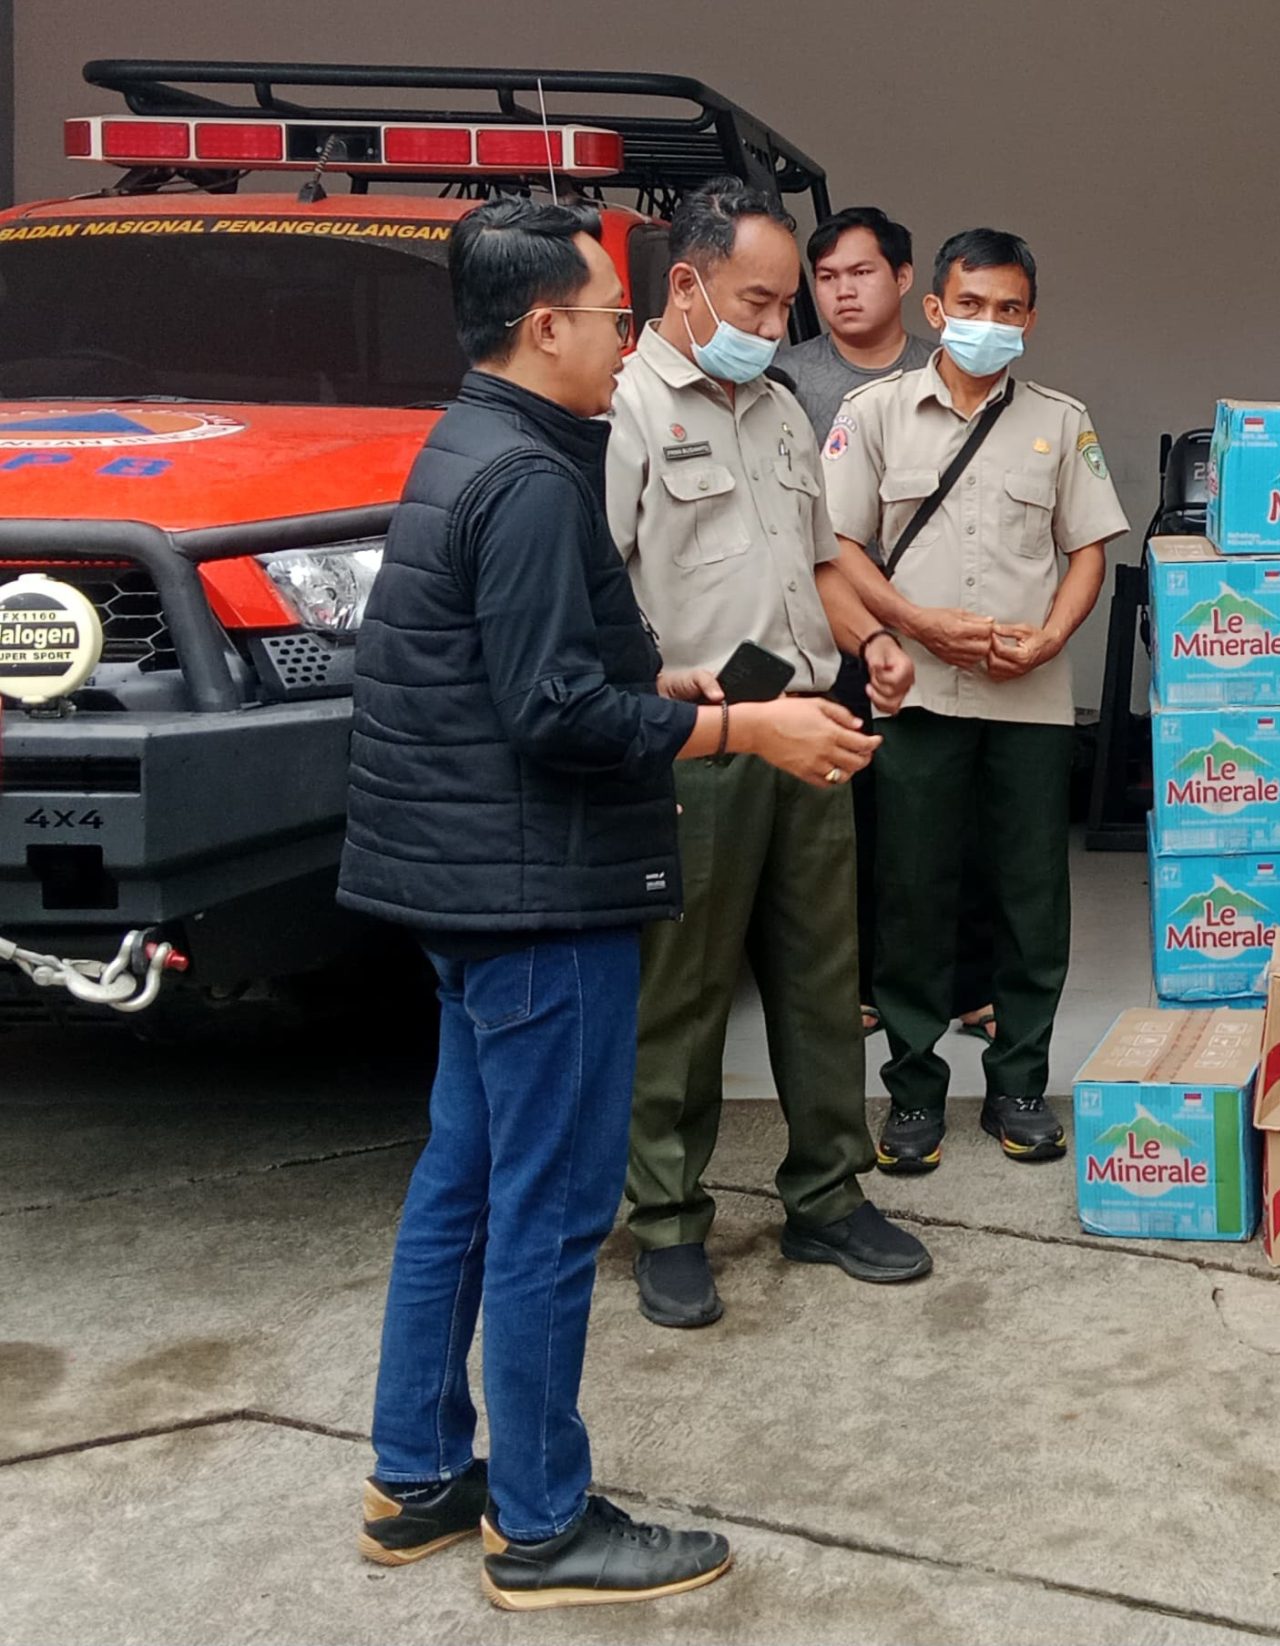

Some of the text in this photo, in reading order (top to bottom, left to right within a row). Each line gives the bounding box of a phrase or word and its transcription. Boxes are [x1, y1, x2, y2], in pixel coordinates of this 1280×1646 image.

[0, 219, 450, 241] BADAN NASIONAL PENANGGULANGAN
[2, 612, 57, 621] FX1160
[1213, 608, 1243, 634] Le
[0, 623, 76, 649] alogen
[33, 651, 72, 660] SPORT
[1206, 755, 1236, 781] Le
[1167, 777, 1279, 805] Minerale
[1206, 901, 1236, 927] Le
[1166, 922, 1276, 949] Minerale
[1128, 1132, 1161, 1160] Le
[1087, 1155, 1207, 1184] Minerale
